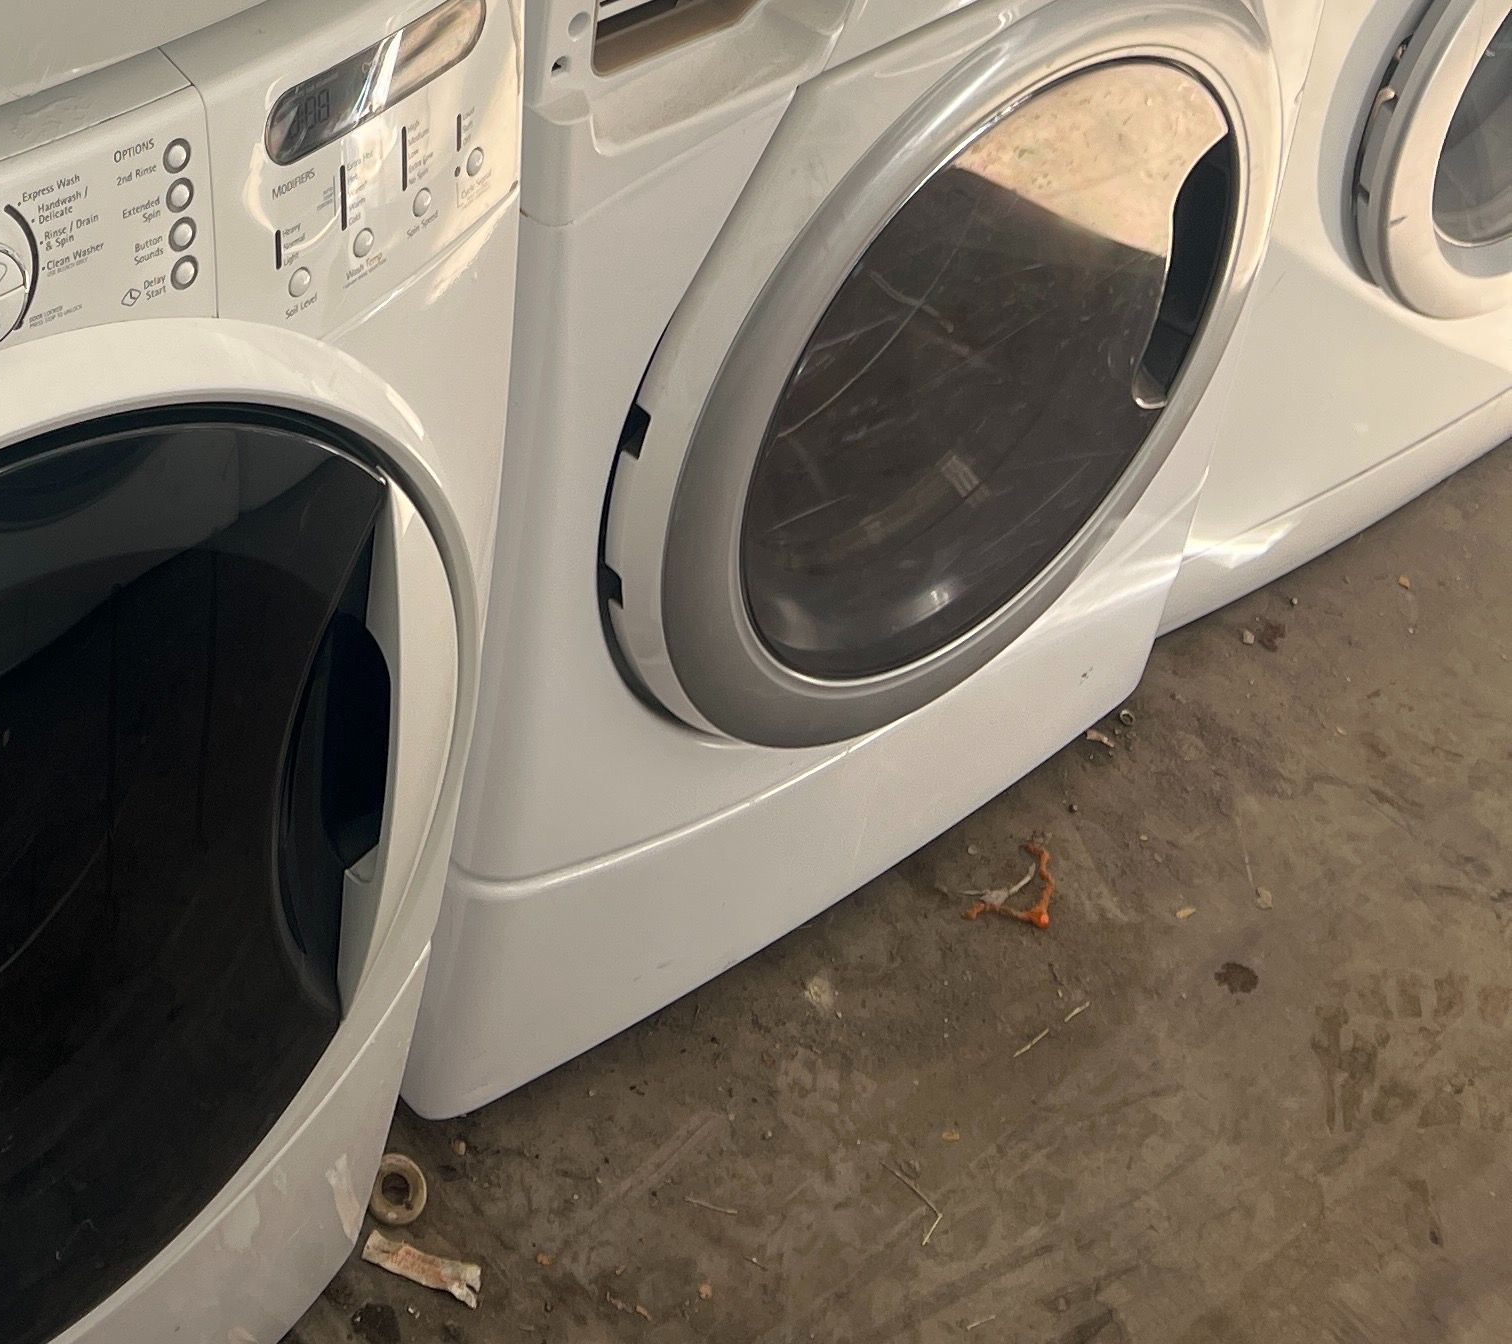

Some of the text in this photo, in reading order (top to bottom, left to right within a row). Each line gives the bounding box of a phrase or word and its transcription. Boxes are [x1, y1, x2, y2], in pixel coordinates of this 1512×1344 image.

[113, 138, 155, 163] OPTIONS
[116, 164, 157, 186] 2nd Rinse
[272, 168, 315, 200] MODIFIERS
[22, 174, 80, 203] Express Wash
[38, 191, 82, 213] Handwash
[123, 196, 160, 219] Extended
[39, 205, 73, 224] Delicate
[143, 208, 161, 224] Spin
[44, 226, 66, 241] Rinse
[76, 214, 99, 229] Drain
[56, 234, 74, 250] Spin
[135, 235, 163, 253] Button
[46, 254, 70, 271] Clean
[73, 242, 104, 260] Washer
[134, 247, 164, 265] Sounds
[144, 275, 166, 290] Delay
[146, 285, 167, 300] Start
